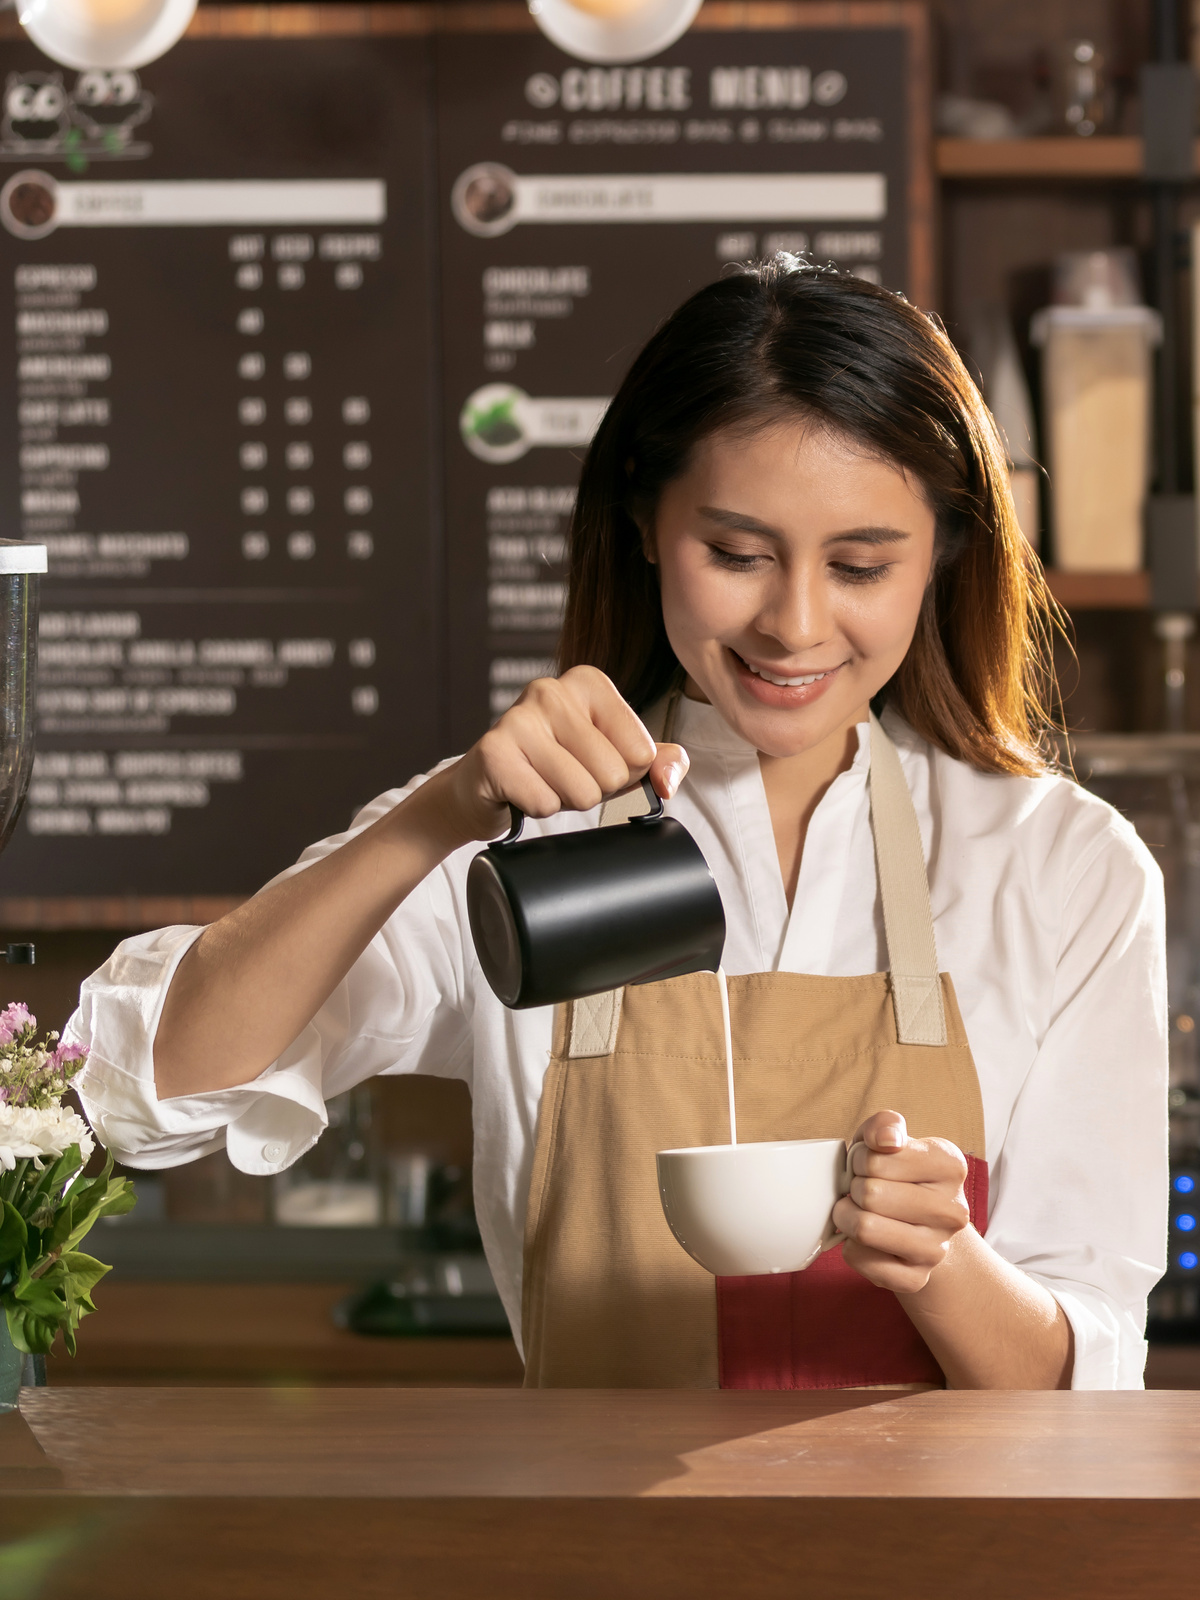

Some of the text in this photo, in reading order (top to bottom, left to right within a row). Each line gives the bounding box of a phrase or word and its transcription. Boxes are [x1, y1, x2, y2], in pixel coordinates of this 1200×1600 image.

[562, 67, 810, 109] COFFEE MENU
[484, 269, 589, 295] CHOCOLATE
[486, 320, 534, 348] MILK
